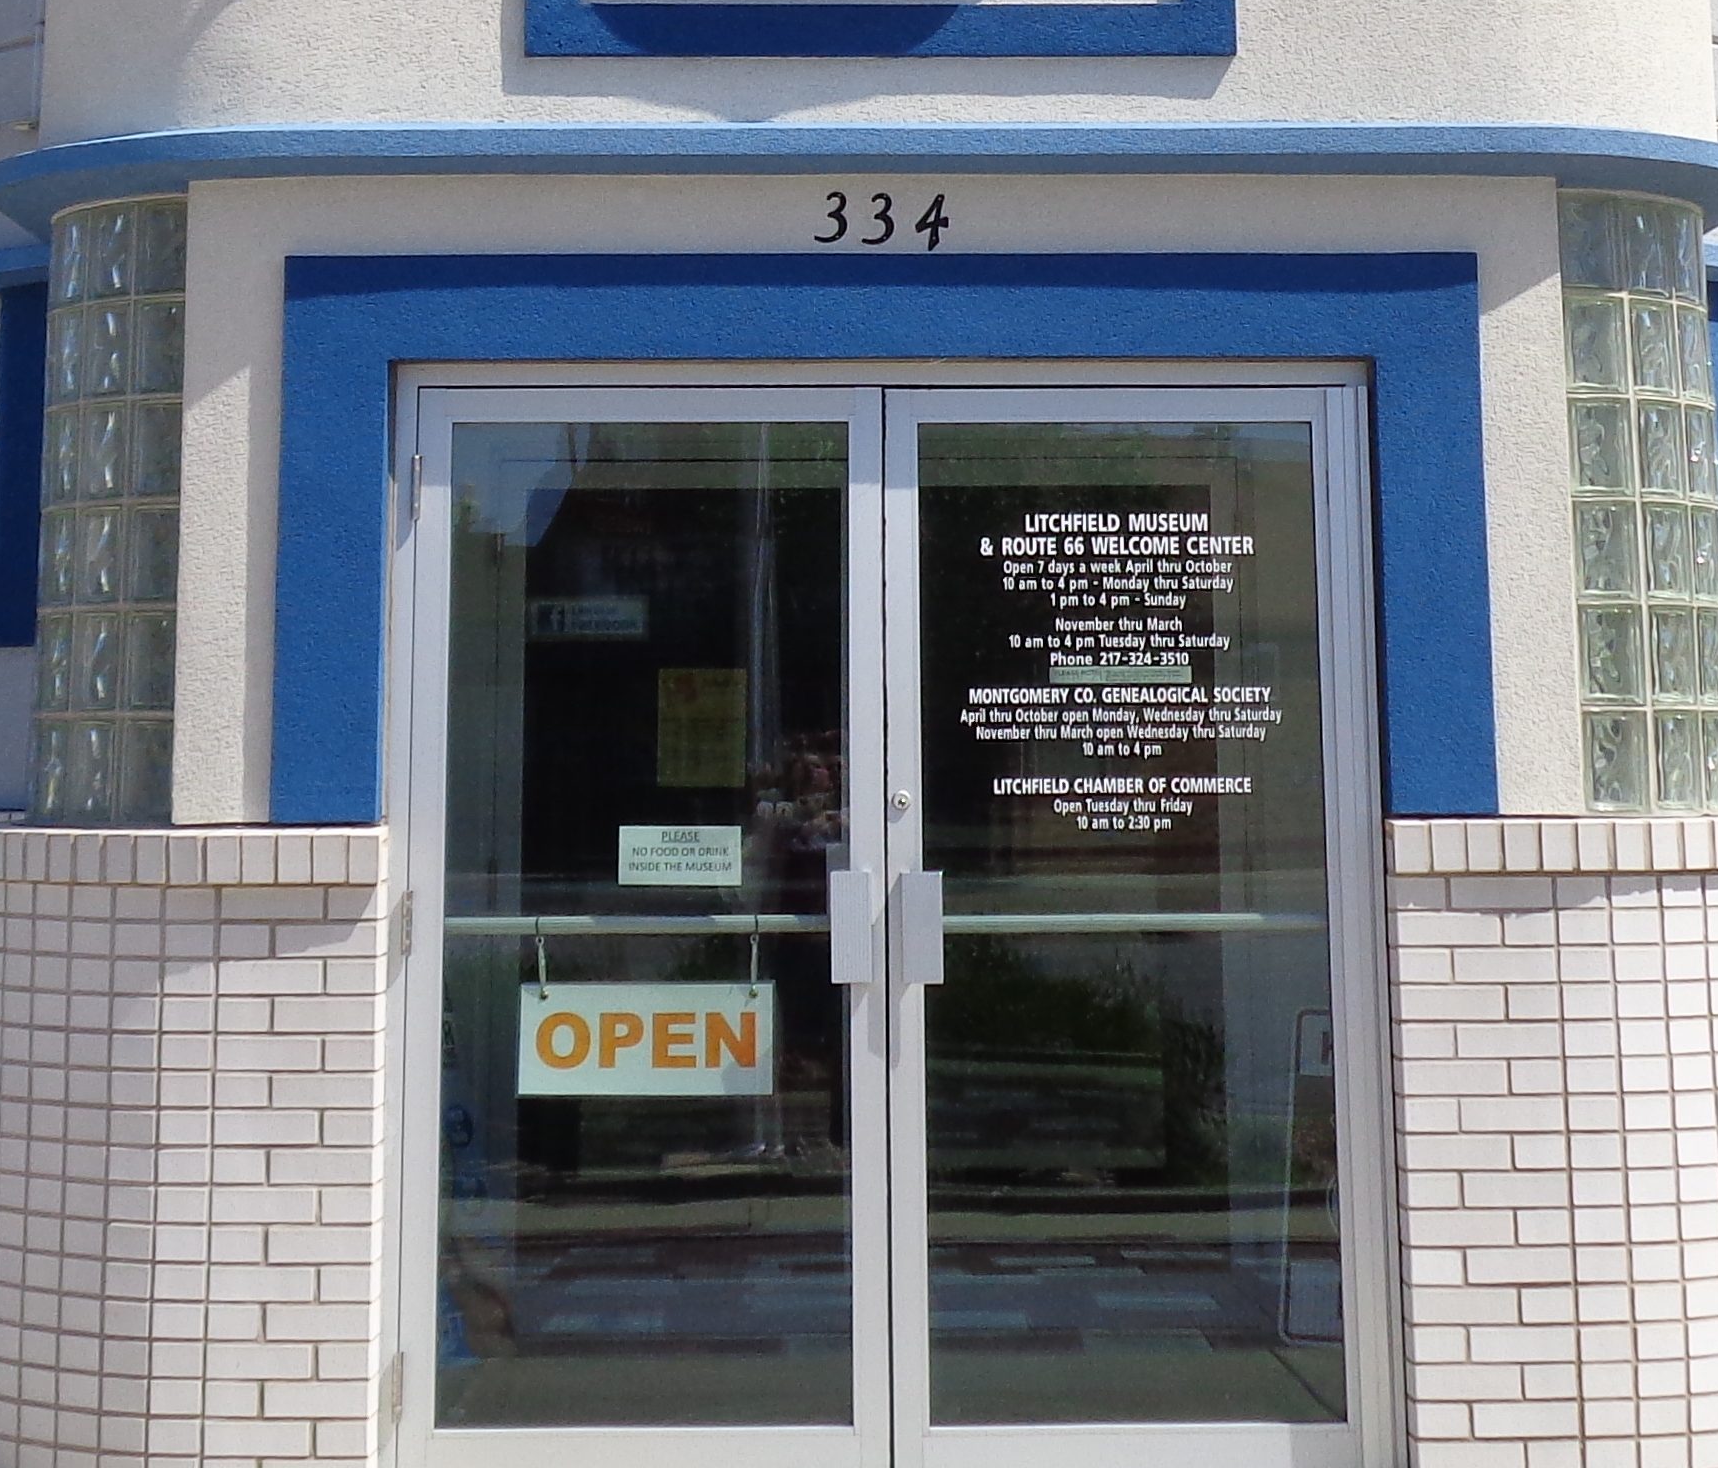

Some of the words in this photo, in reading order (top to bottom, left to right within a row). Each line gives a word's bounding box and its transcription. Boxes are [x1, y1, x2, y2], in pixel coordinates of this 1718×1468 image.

[814, 191, 949, 252] 334
[1025, 514, 1121, 533] LITCHFIELD
[1128, 513, 1209, 532] MUSEUM
[979, 537, 994, 556] &
[1001, 536, 1058, 556] ROUTE
[1063, 535, 1085, 556] 66
[1090, 535, 1180, 556] WELCOME
[1186, 535, 1254, 555] CENTER
[1003, 560, 1034, 576] Open
[1037, 560, 1045, 574] 7
[1047, 558, 1075, 576] days
[1079, 562, 1087, 574] a
[1089, 560, 1122, 574] week
[1125, 558, 1154, 576] April
[1156, 558, 1182, 573] thru
[1185, 559, 1233, 574] October
[1002, 576, 1016, 591] 10
[1018, 579, 1038, 591] am
[1040, 577, 1054, 591] to
[1057, 574, 1067, 590] 4
[1069, 578, 1089, 593] pm
[1102, 576, 1150, 593] Monday
[1153, 576, 1179, 591] thru
[1181, 576, 1234, 593] Saturday
[1050, 592, 1056, 607] 1
[1059, 596, 1079, 610] pm
[1082, 593, 1096, 607] to
[1099, 591, 1107, 606] 4
[1110, 595, 1130, 610] pm
[1143, 592, 1187, 610] Sunday
[1055, 616, 1115, 632] November
[1117, 616, 1143, 631] thru
[1146, 615, 1183, 632] March
[1008, 633, 1021, 648] 10
[1024, 637, 1044, 649] am
[1047, 634, 1061, 648] to
[1064, 633, 1072, 648] 4
[1075, 636, 1095, 651] pm
[1097, 632, 1147, 651] Tuesday
[1149, 632, 1175, 648] thru
[1178, 632, 1231, 651] Saturday
[1050, 650, 1093, 666] Phone
[1099, 651, 1190, 666] 217-324-3510
[968, 687, 1070, 705] MONTGOMERY
[1073, 687, 1097, 704] CO.
[1101, 686, 1209, 704] GENEALOGICAL
[1213, 686, 1271, 703] SOCIETY
[959, 708, 986, 725] April
[988, 706, 1013, 723] thru
[1015, 707, 1059, 723] October
[1061, 710, 1089, 725] open
[1092, 707, 1140, 725] Monday,
[1142, 706, 1205, 725] Wednesday
[1208, 706, 1232, 722] thru
[1234, 706, 1282, 725] Saturday
[975, 723, 1031, 740] November
[1034, 724, 1058, 740] thru
[1060, 723, 1094, 740] March
[1096, 727, 1124, 742] open
[1126, 723, 1189, 742] Wednesday
[1191, 723, 1216, 739] thru
[1217, 723, 1266, 742] Saturday
[1082, 741, 1094, 756] 10
[1097, 744, 1115, 756] am
[1117, 742, 1131, 757] to
[1133, 740, 1141, 756] 4
[1143, 744, 1162, 759] pm
[993, 777, 1070, 795] LITCHFIELD
[1073, 777, 1144, 794] CHAMBER
[1148, 777, 1167, 794] OF
[1170, 776, 1252, 794] COMMERCE
[1053, 800, 1083, 816] Open
[1085, 797, 1130, 816] Tuesday
[1132, 799, 1156, 814] thru
[1160, 797, 1193, 816] Friday
[1076, 815, 1089, 830] 10
[1091, 817, 1109, 830] am
[1112, 817, 1126, 830] to
[1128, 816, 1151, 830] 2:30
[1153, 819, 1172, 833] pm
[661, 831, 700, 842] PLEASE
[632, 847, 648, 857] NO
[650, 847, 679, 857] FOOD
[698, 847, 729, 857] DRINK
[629, 861, 661, 872] INSIDE
[663, 861, 683, 872] THE
[685, 861, 732, 872] MUSEUM
[535, 1010, 757, 1070] OPEN
